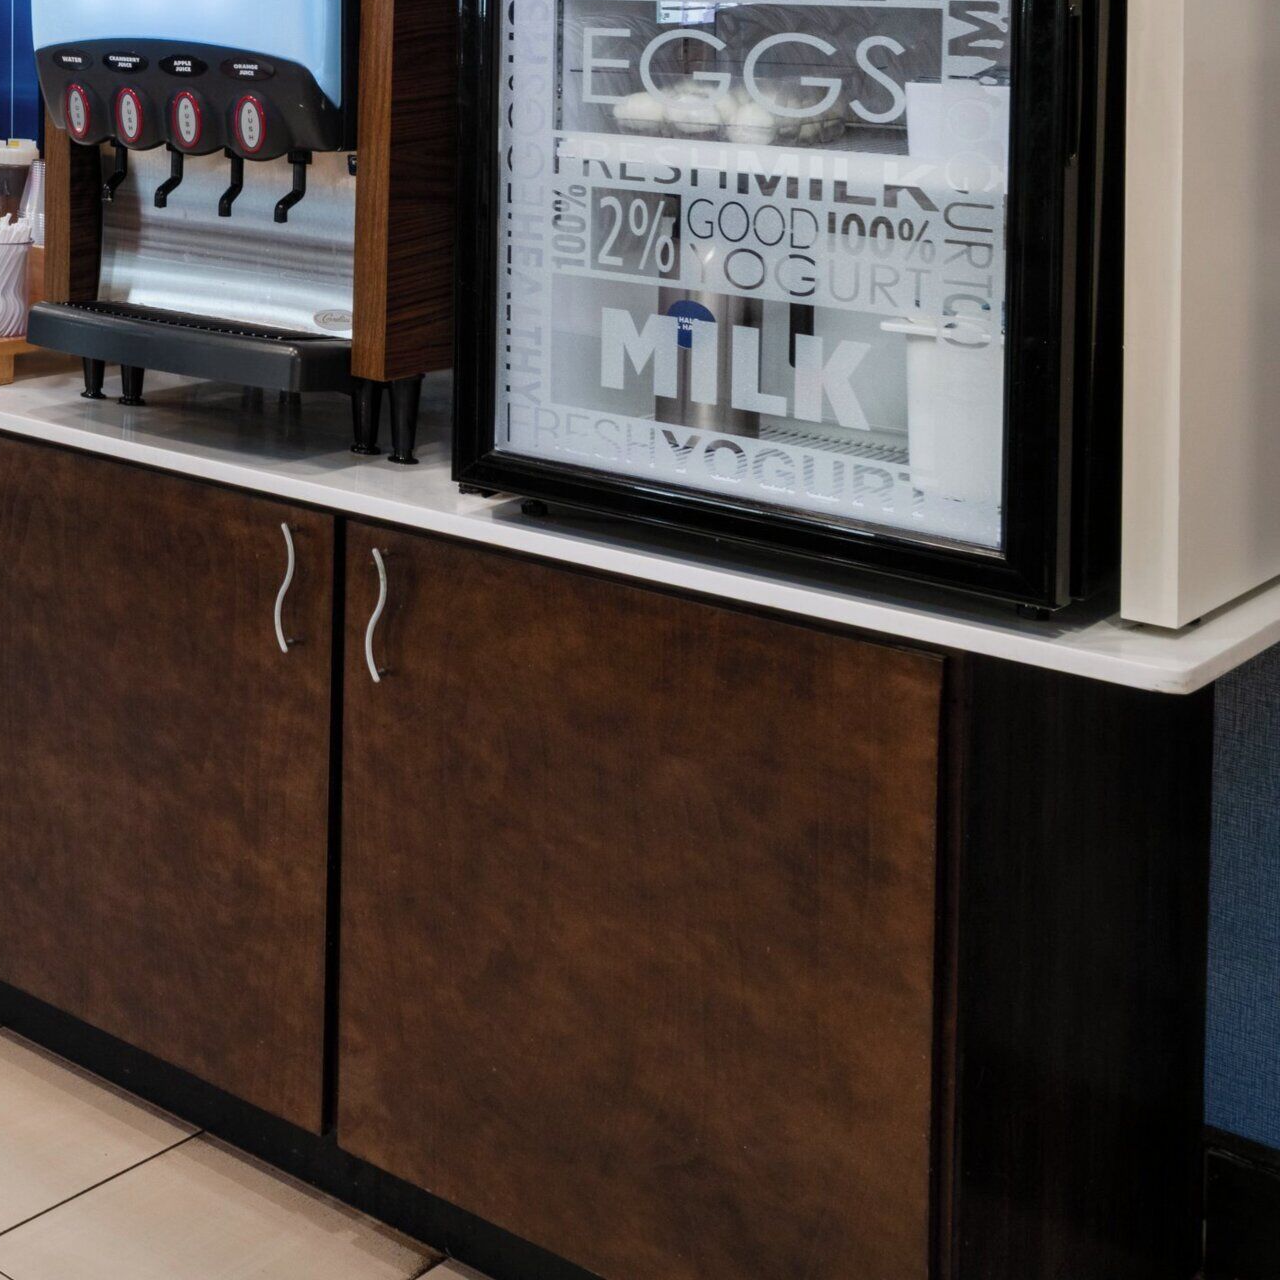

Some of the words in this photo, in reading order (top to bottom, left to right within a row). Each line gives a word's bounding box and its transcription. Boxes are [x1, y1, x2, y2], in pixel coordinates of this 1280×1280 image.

[62, 56, 82, 64] WATER
[109, 55, 140, 64] CRANBERRY
[582, 26, 907, 124] EGGS
[247, 108, 255, 140] PUSH
[736, 148, 942, 213] MILK
[551, 183, 587, 270] 100%
[597, 196, 676, 273] 2%
[687, 198, 820, 251] GOOD
[825, 210, 936, 265] 100%
[688, 242, 933, 308] YOGURT
[600, 307, 872, 432] MILK
